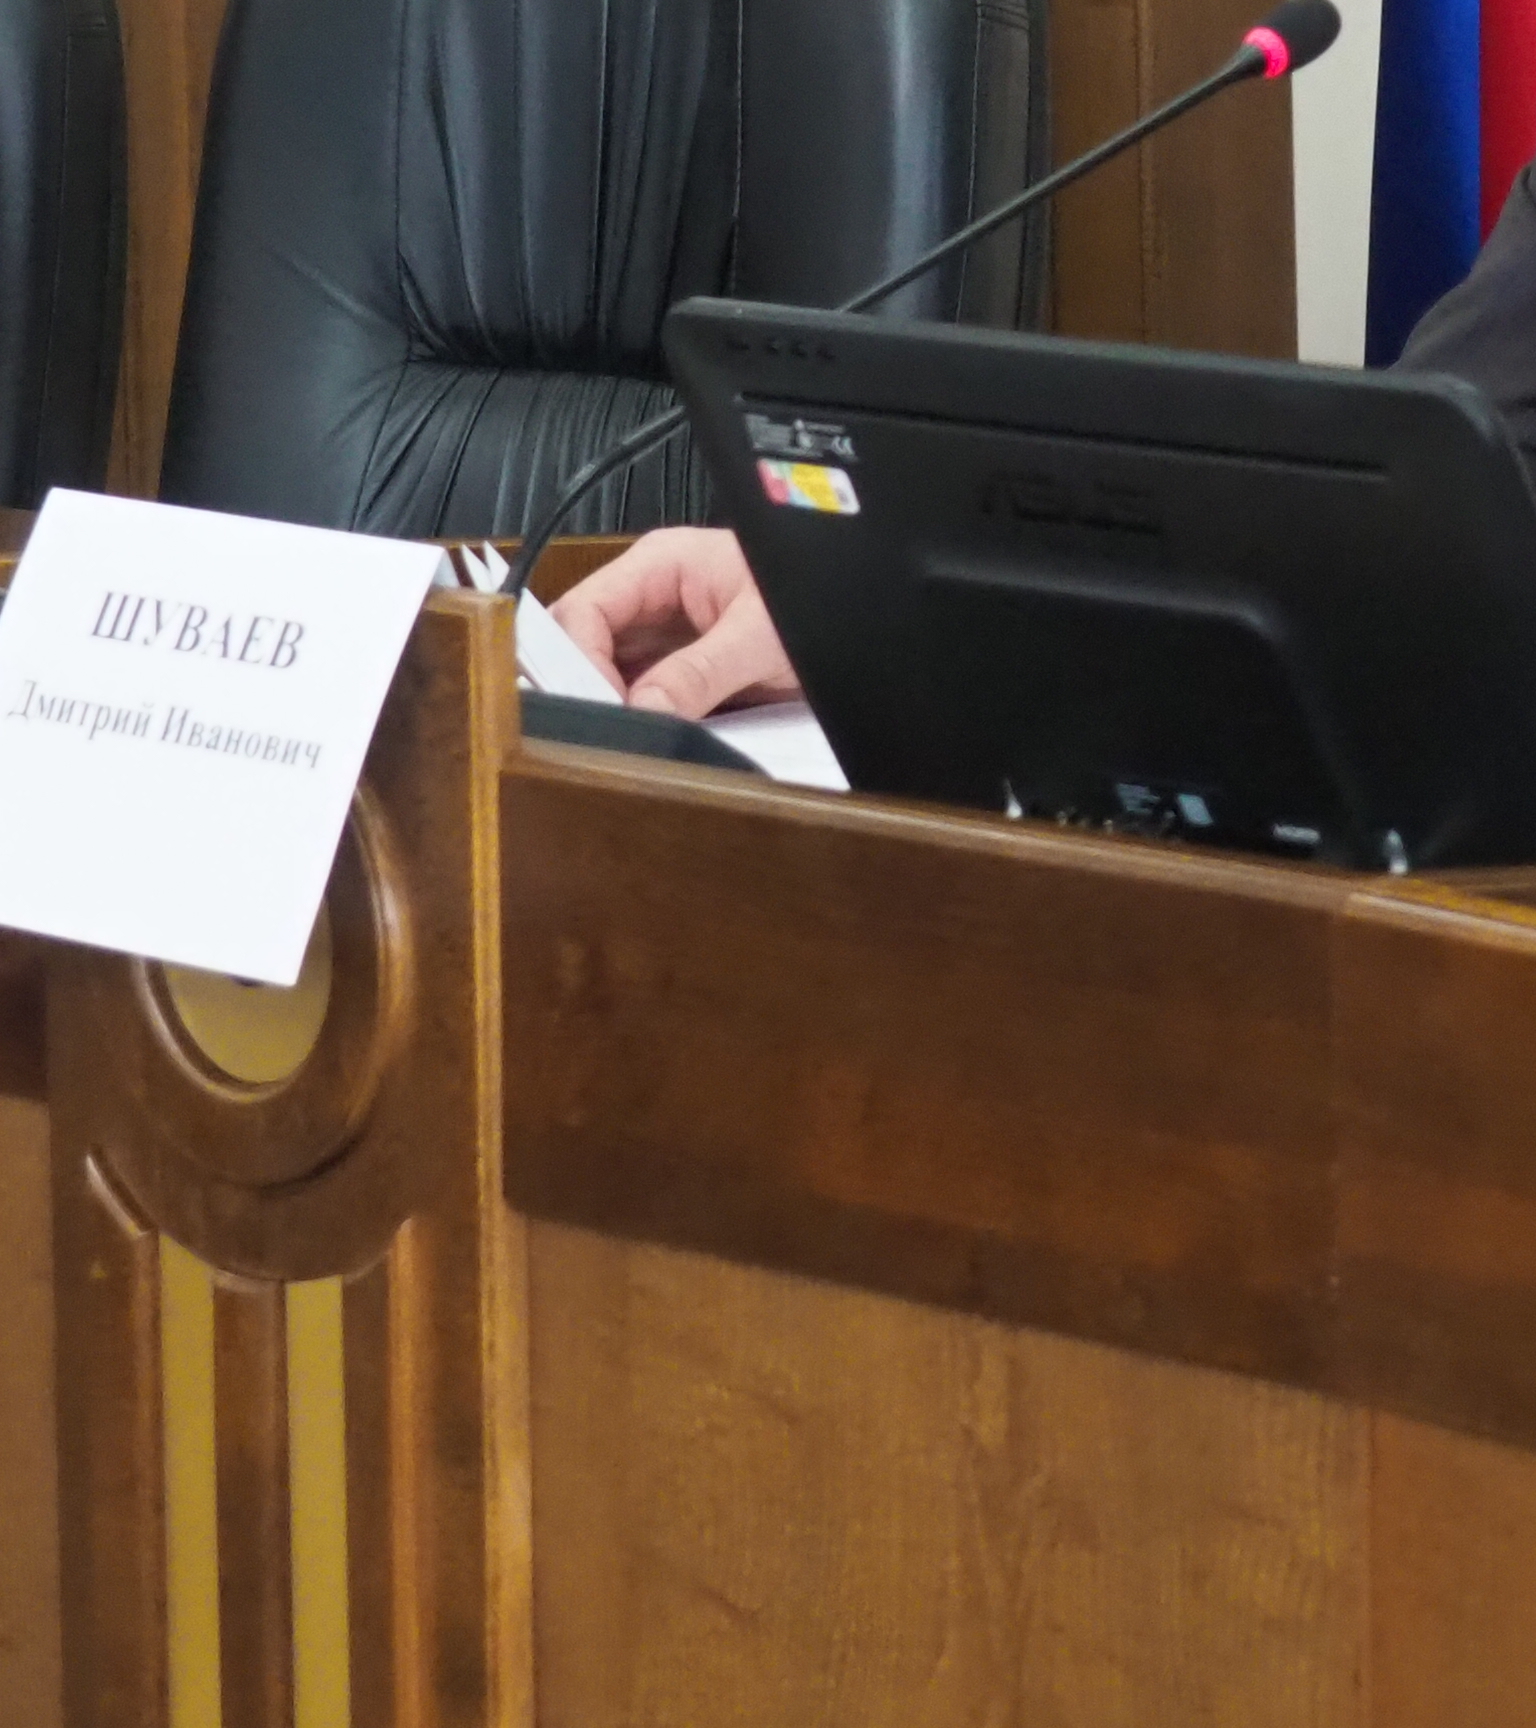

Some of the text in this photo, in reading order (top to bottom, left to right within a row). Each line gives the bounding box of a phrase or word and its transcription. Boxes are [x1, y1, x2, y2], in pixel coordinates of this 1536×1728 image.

[89, 590, 307, 671] ШУВАЕВ
[5, 678, 323, 770] Дмитрий Иванович
